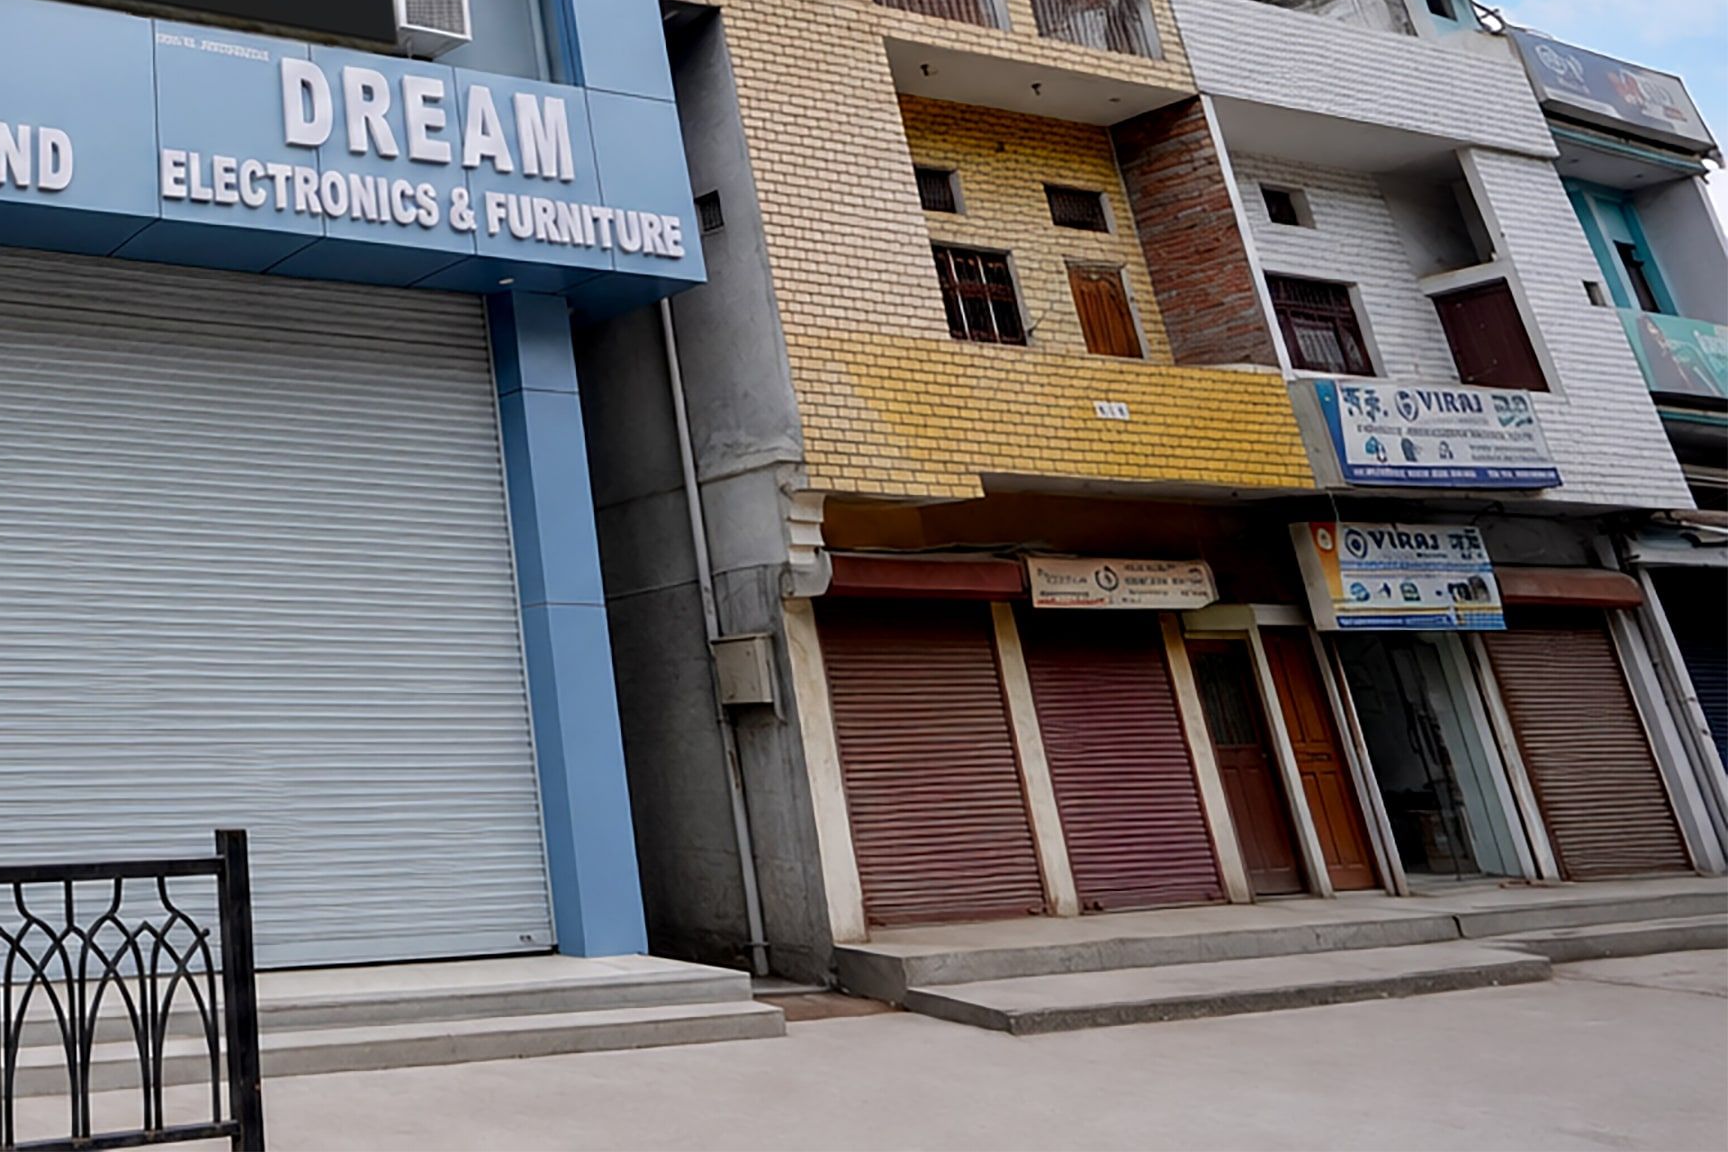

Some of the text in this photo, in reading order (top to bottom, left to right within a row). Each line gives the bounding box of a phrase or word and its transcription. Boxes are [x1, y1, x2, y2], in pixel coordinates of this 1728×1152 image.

[280, 57, 574, 181] DREAM
[162, 149, 685, 259] ELECTRONICS & FURNITURE
[1416, 390, 1484, 414] VIRAJ
[1368, 530, 1440, 552] VIRAJ
